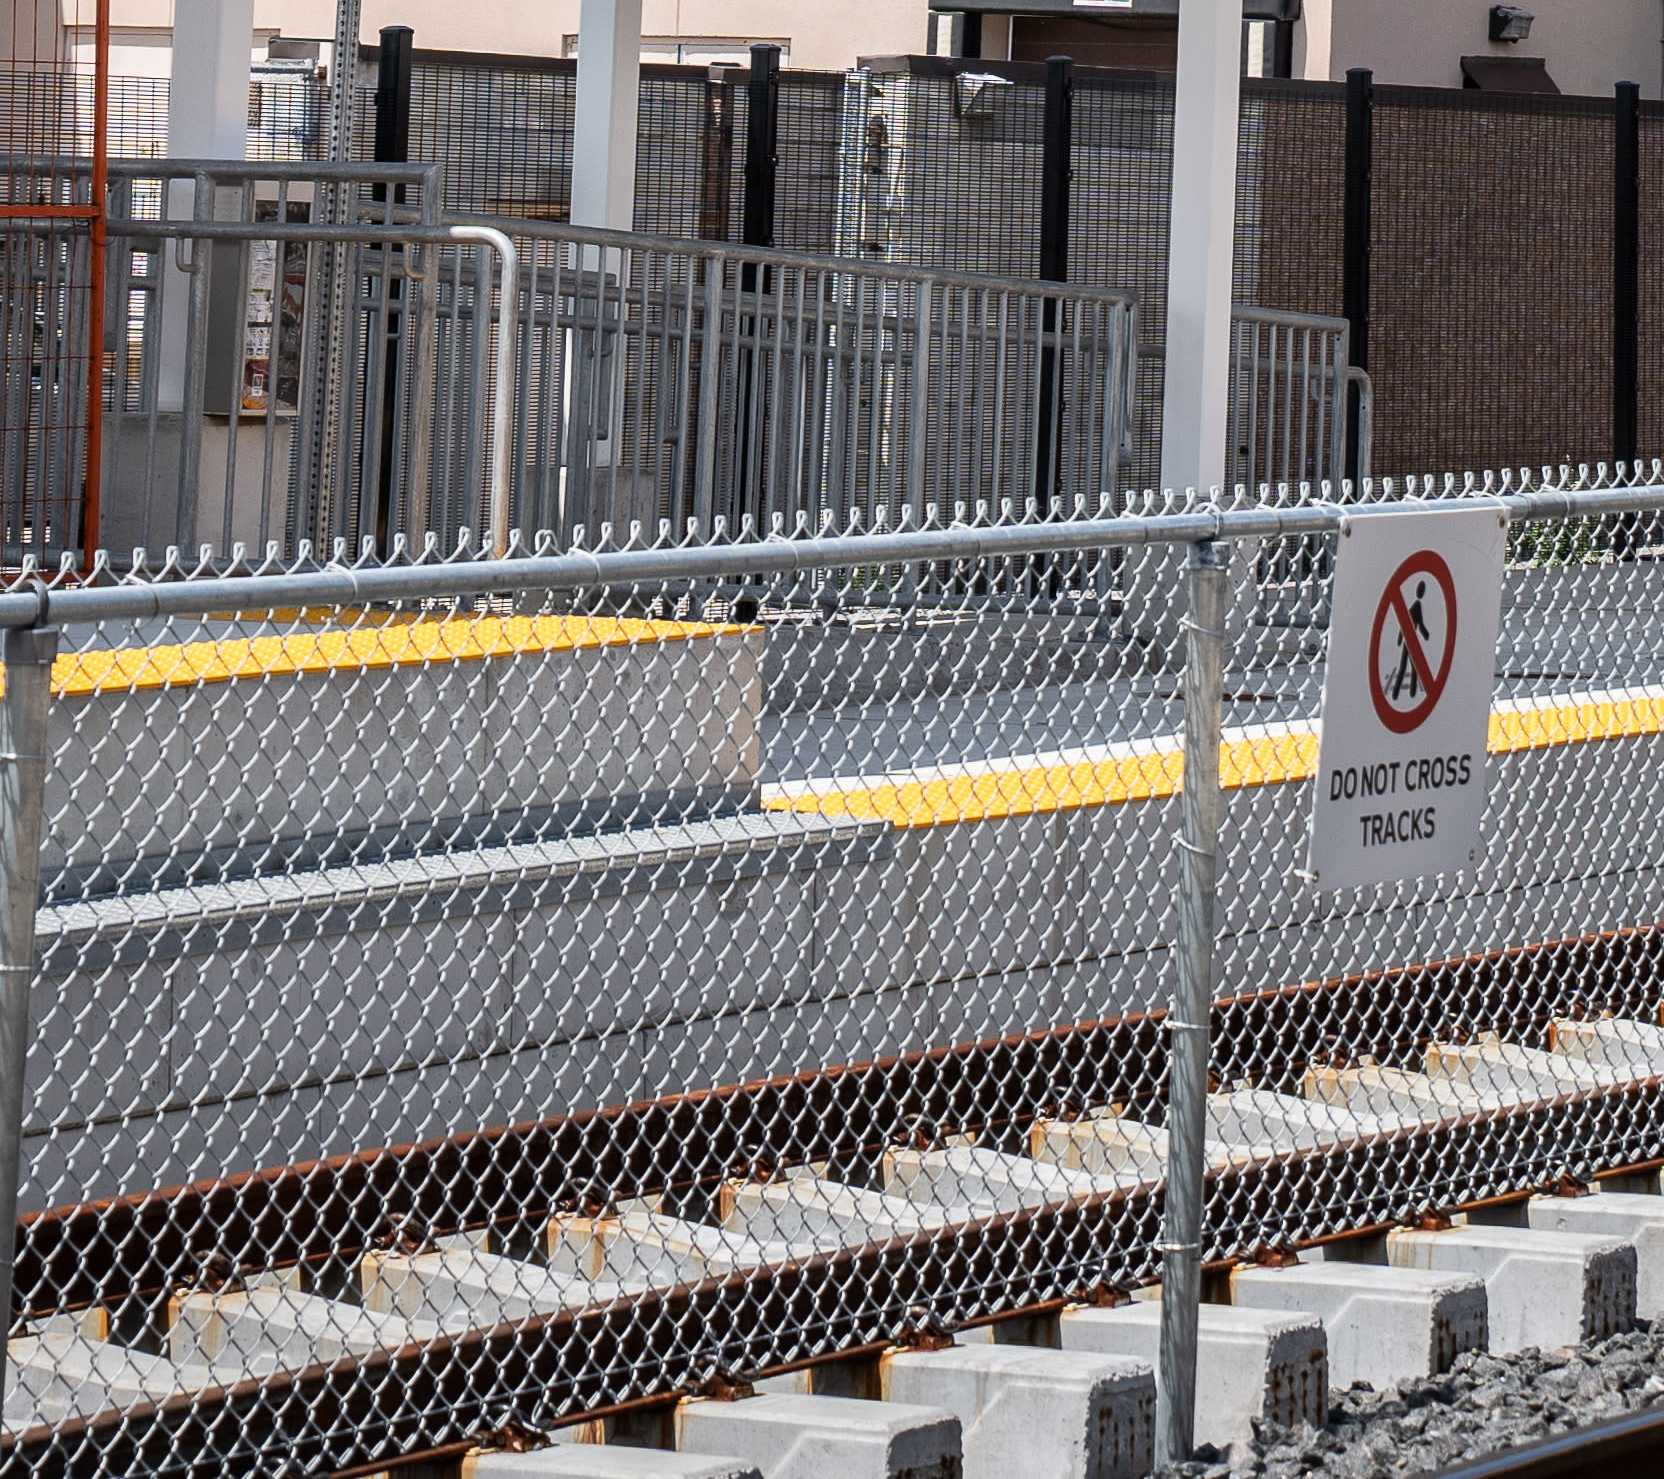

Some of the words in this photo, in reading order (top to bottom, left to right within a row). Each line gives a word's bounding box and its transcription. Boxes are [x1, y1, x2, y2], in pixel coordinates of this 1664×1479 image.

[1330, 767, 1358, 802] DO
[1360, 761, 1401, 798] NOT
[1404, 753, 1472, 792] CROSS
[1359, 806, 1436, 848] TRACKS
